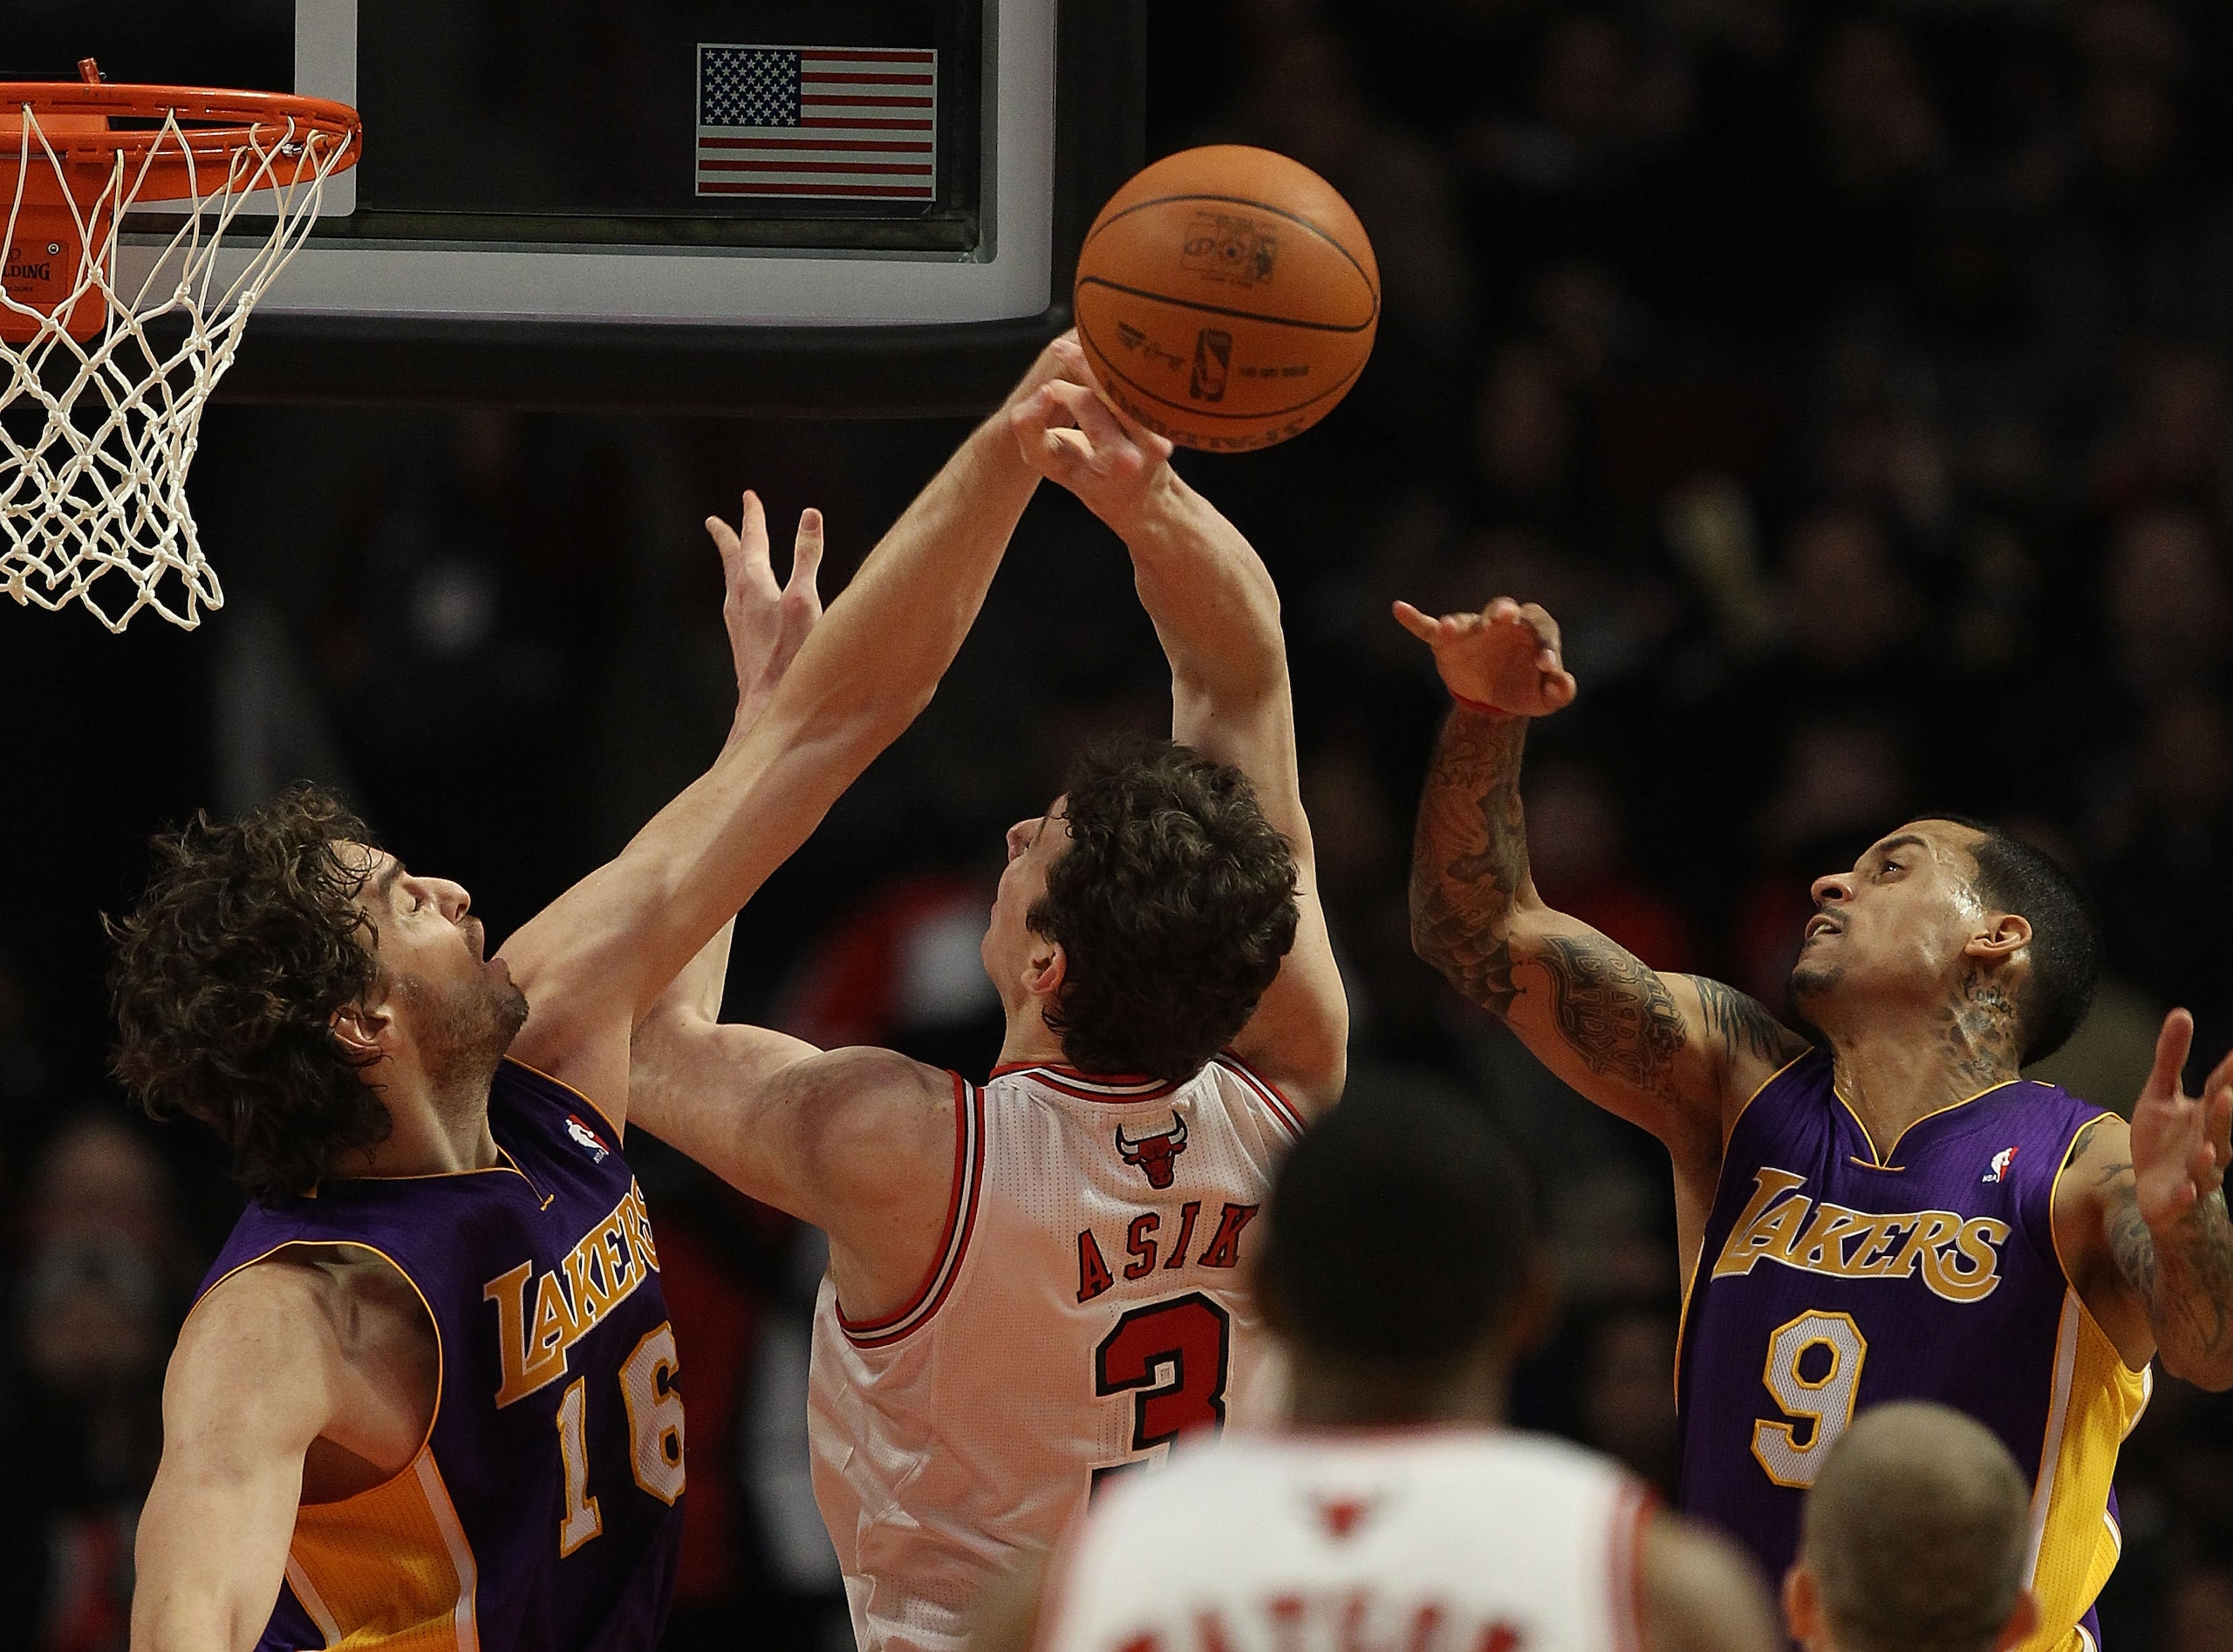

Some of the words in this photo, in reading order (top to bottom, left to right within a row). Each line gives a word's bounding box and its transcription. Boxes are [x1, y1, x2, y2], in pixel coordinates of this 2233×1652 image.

[483, 1173, 661, 1410] LAKERS
[1076, 1200, 1260, 1304] ASIK
[1711, 1166, 2013, 1304] LAKERS
[557, 1320, 686, 1560] 16
[1090, 1290, 1231, 1511] 3
[1751, 1309, 1868, 1490] 9
